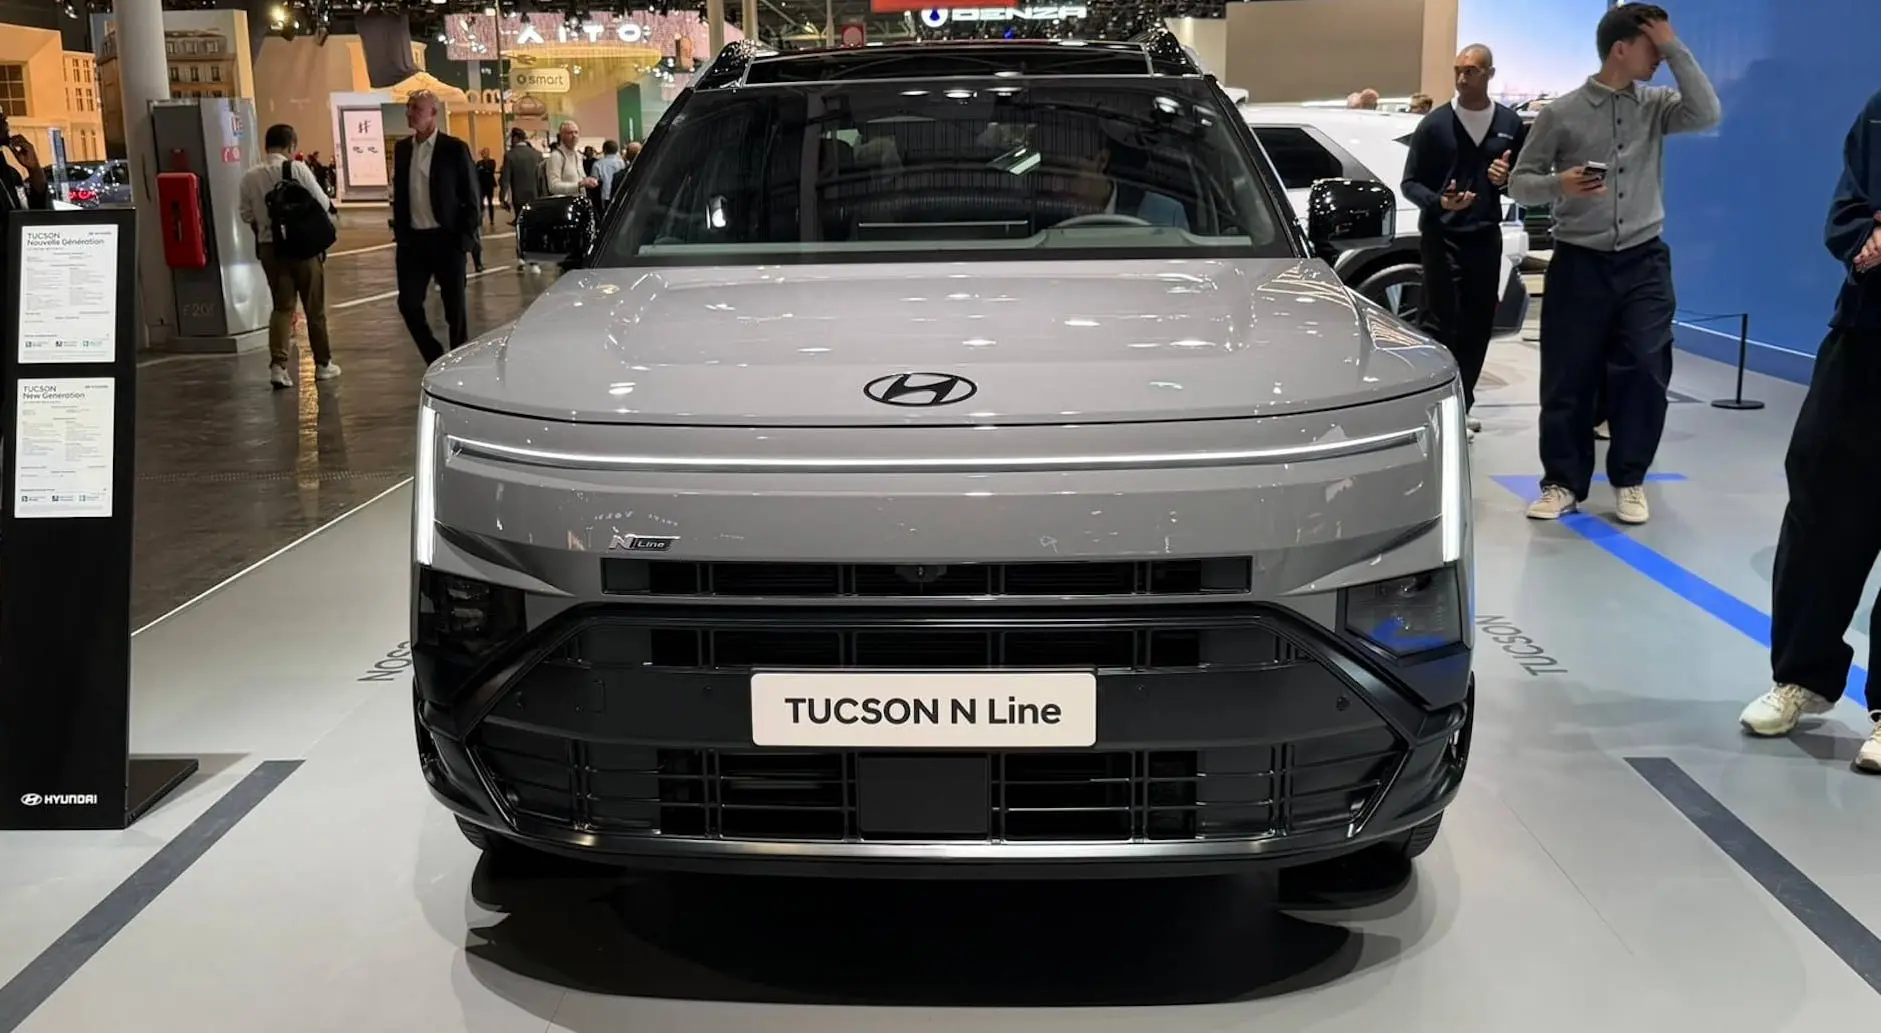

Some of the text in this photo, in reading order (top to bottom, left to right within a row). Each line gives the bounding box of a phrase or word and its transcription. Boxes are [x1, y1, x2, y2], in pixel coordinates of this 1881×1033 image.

[951, 7, 1088, 21] DENZA
[516, 23, 644, 44] AITO
[528, 73, 564, 85] smart
[27, 232, 61, 240] TUCSON
[24, 385, 57, 393] TUCSON
[23, 391, 86, 400] New Generation
[1475, 614, 1568, 677] TUCSON
[784, 696, 1062, 725] TUCSON N Line
[44, 794, 98, 805] HYUNDAI
